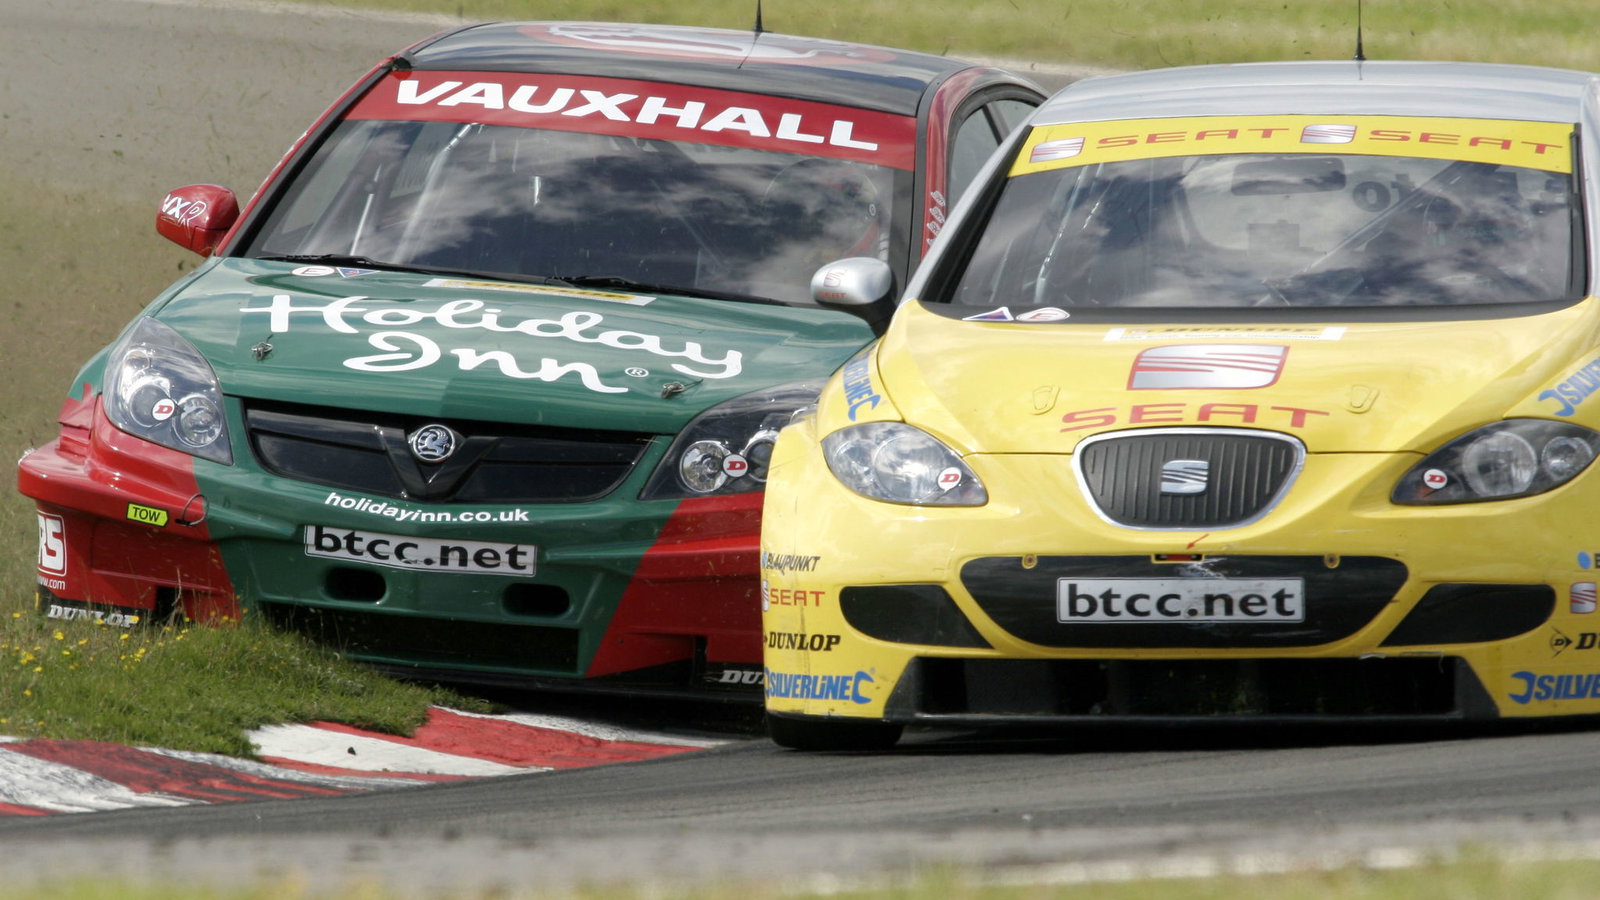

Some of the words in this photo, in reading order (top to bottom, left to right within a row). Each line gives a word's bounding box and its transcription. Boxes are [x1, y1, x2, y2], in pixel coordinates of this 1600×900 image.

[397, 79, 878, 151] VAUXHALL
[1097, 127, 1290, 149] SEAT
[1369, 130, 1563, 155] SEAT
[239, 295, 743, 379] Holiday
[343, 331, 628, 393] Inn
[1059, 403, 1330, 432] SEAT
[132, 506, 161, 522] TOW
[324, 492, 529, 522] holidayinn.co.uk
[314, 525, 527, 570] btcc.net
[770, 588, 825, 607] SEAT
[1068, 583, 1295, 617] btcc.net
[768, 631, 841, 651] DUNLOP
[1575, 633, 1600, 650] D
[719, 669, 764, 685] DU
